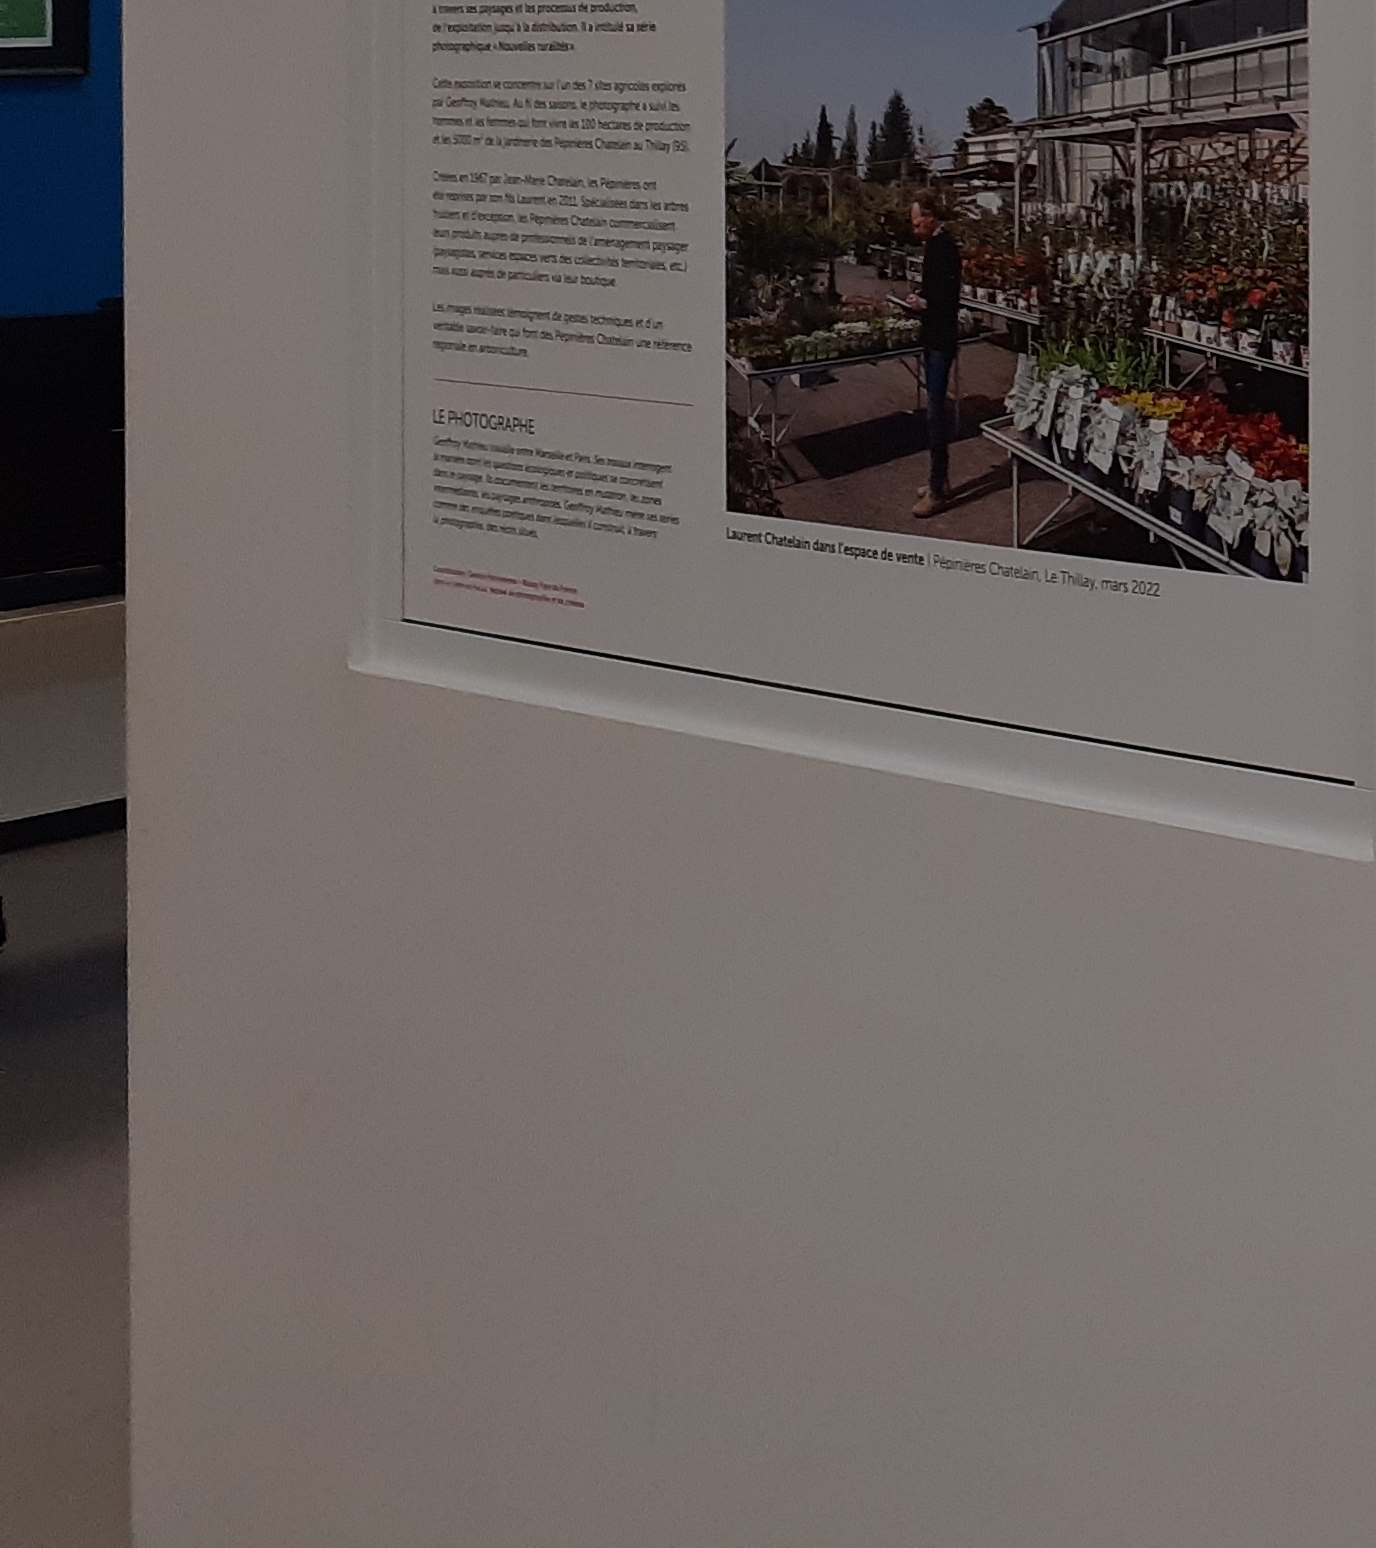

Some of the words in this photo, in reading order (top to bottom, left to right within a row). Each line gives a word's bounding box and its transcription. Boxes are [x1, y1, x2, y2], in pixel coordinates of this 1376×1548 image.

[433, 409, 445, 424] LE
[448, 410, 535, 435] PHOTOGRAPHE
[726, 527, 762, 543] Laurent
[764, 532, 810, 550] Chatelain
[813, 539, 835, 553] dans
[838, 542, 877, 560] l'espace
[881, 548, 892, 561] de
[896, 553, 924, 565] vente
[1045, 569, 1057, 583] Le
[1132, 580, 1161, 597] 2022
